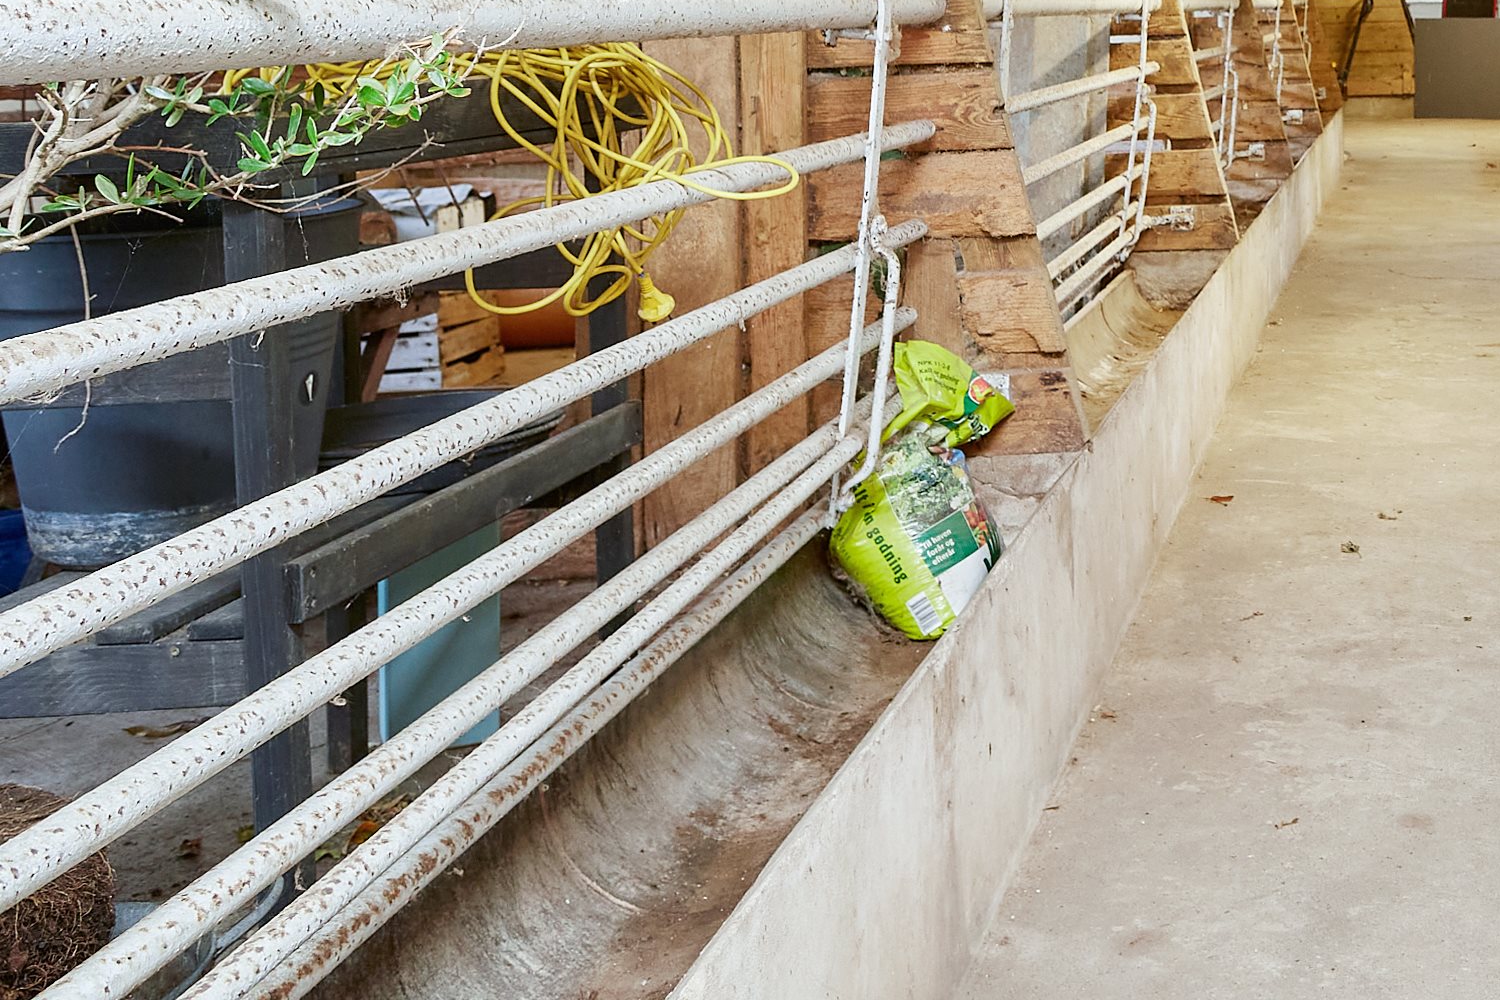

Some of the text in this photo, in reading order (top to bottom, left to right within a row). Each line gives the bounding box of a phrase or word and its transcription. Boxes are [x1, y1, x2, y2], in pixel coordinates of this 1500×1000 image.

[930, 529, 952, 545] haven
[866, 527, 908, 584] gødning
[926, 538, 956, 558] forår og
[931, 547, 956, 566] efterår
